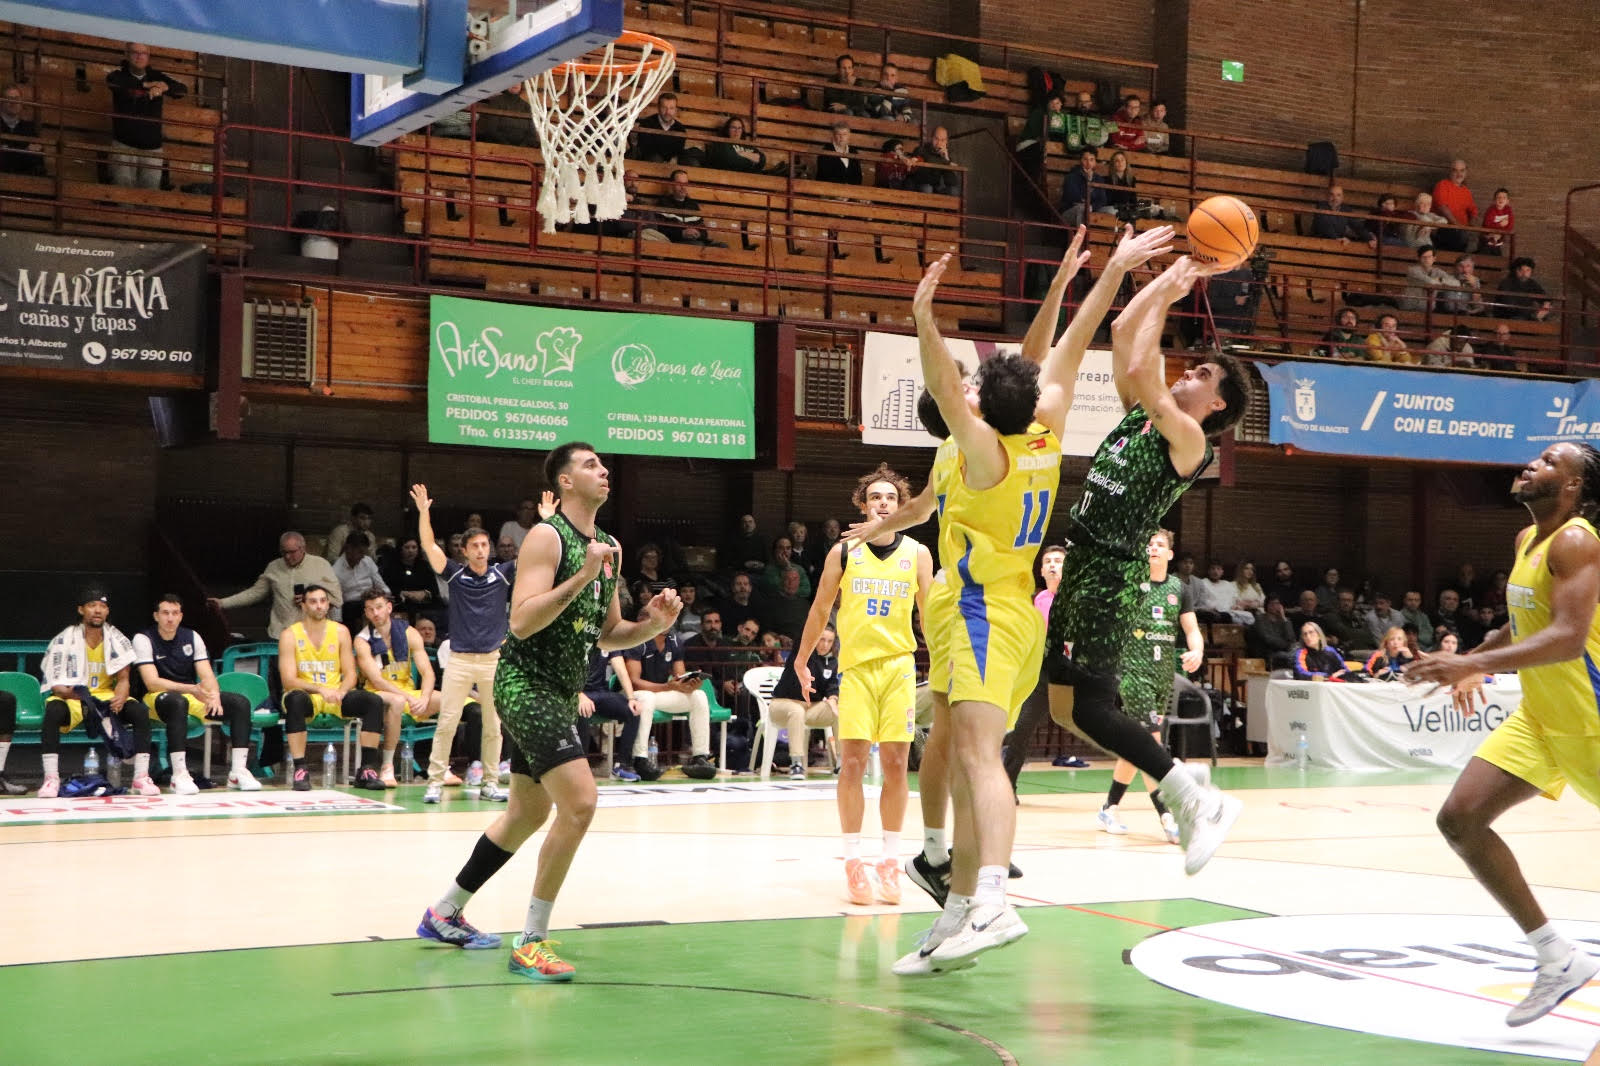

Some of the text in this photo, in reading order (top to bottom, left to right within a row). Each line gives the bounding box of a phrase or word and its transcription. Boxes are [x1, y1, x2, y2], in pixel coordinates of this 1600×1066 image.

[34, 242, 115, 257] lamartena.com
[16, 266, 170, 319] MARTEÑA
[19, 308, 137, 335] cañas y tapas
[28, 338, 68, 349] Albacete
[111, 348, 193, 363] 967 990 610
[656, 361, 687, 376] cosas
[691, 363, 708, 377] de
[1076, 372, 1114, 384] reap
[554, 380, 574, 388] CASA
[558, 402, 569, 410] 30
[1393, 393, 1455, 412] JUNTOS
[446, 407, 569, 426] PEDIDOS 967046066
[680, 416, 704, 426] PLAZA
[458, 424, 557, 441] Tfno. 613357449
[608, 427, 747, 446] PEDIDOS 967 021 818
[1393, 416, 1426, 433] CON
[1427, 418, 1446, 435] EL
[1447, 420, 1516, 439] DEPORTE
[1013, 489, 1050, 549] 11
[852, 577, 911, 598] GETAFE
[866, 598, 892, 617] 55
